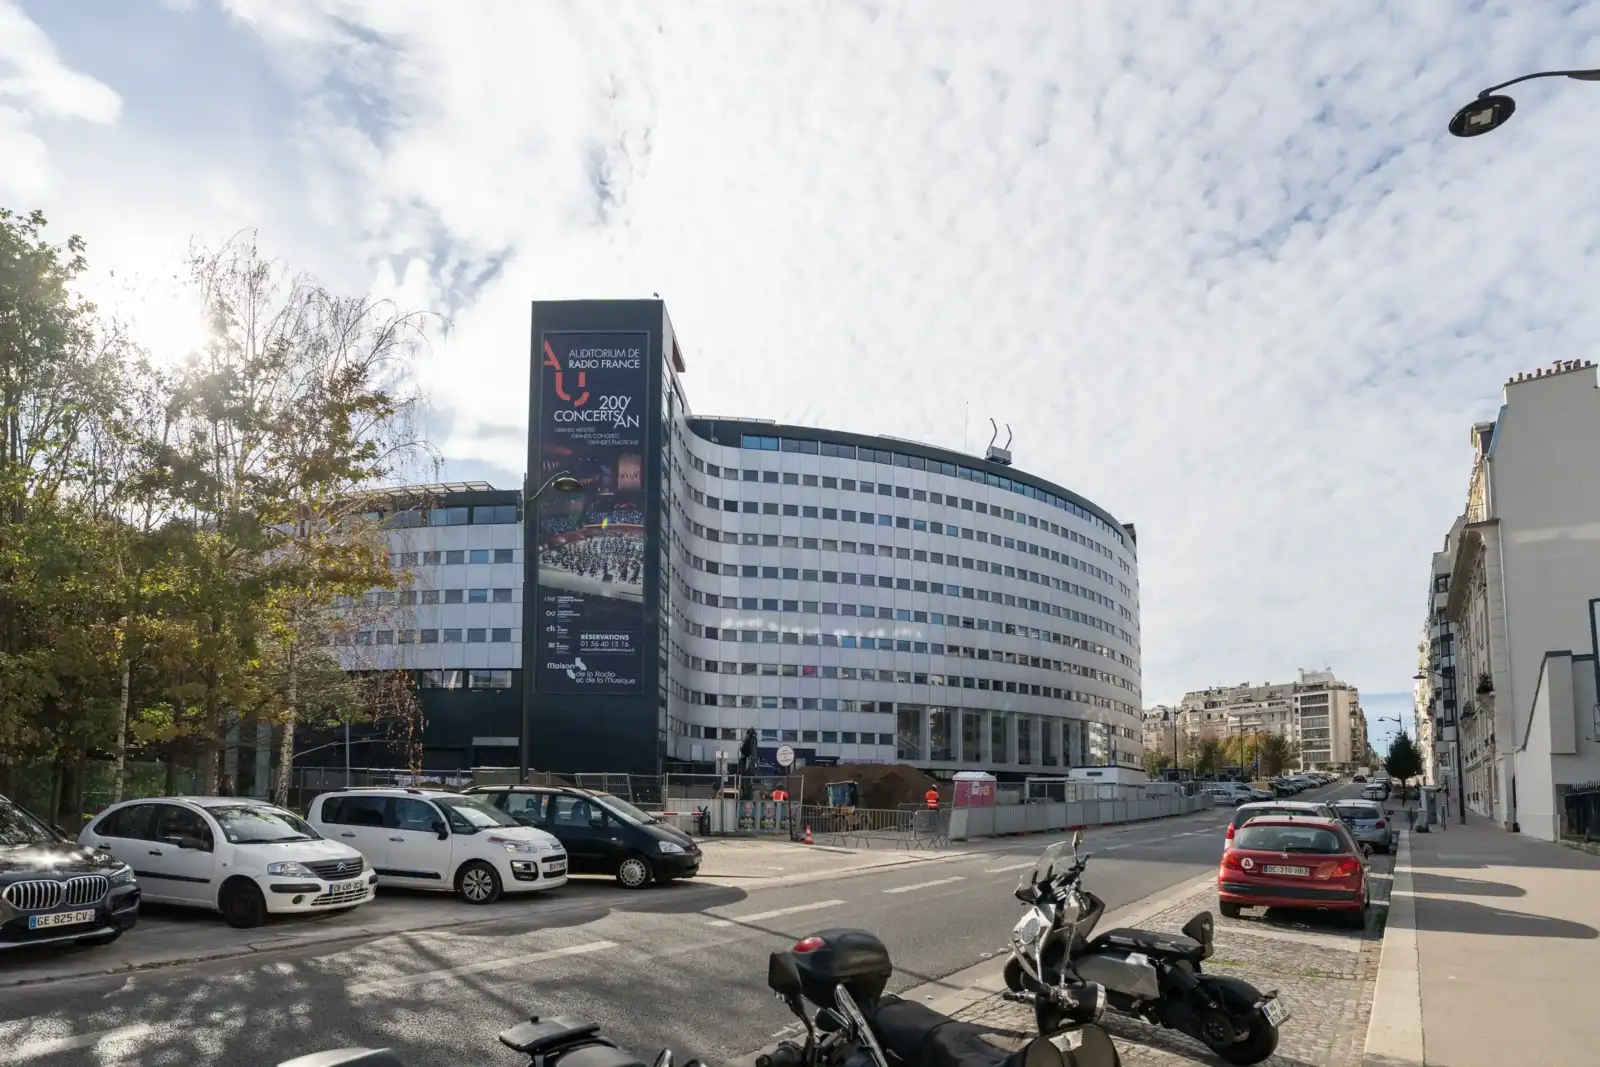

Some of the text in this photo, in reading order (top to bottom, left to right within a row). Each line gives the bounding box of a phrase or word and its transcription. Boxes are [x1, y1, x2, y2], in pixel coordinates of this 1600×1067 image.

[568, 349, 640, 358] AUDITORIUM DE
[568, 359, 640, 369] RADIO FRANCE
[554, 410, 620, 422] CONCERTS
[547, 662, 575, 670] Maison
[605, 677, 636, 685] Musique
[1244, 859, 1251, 867] A
